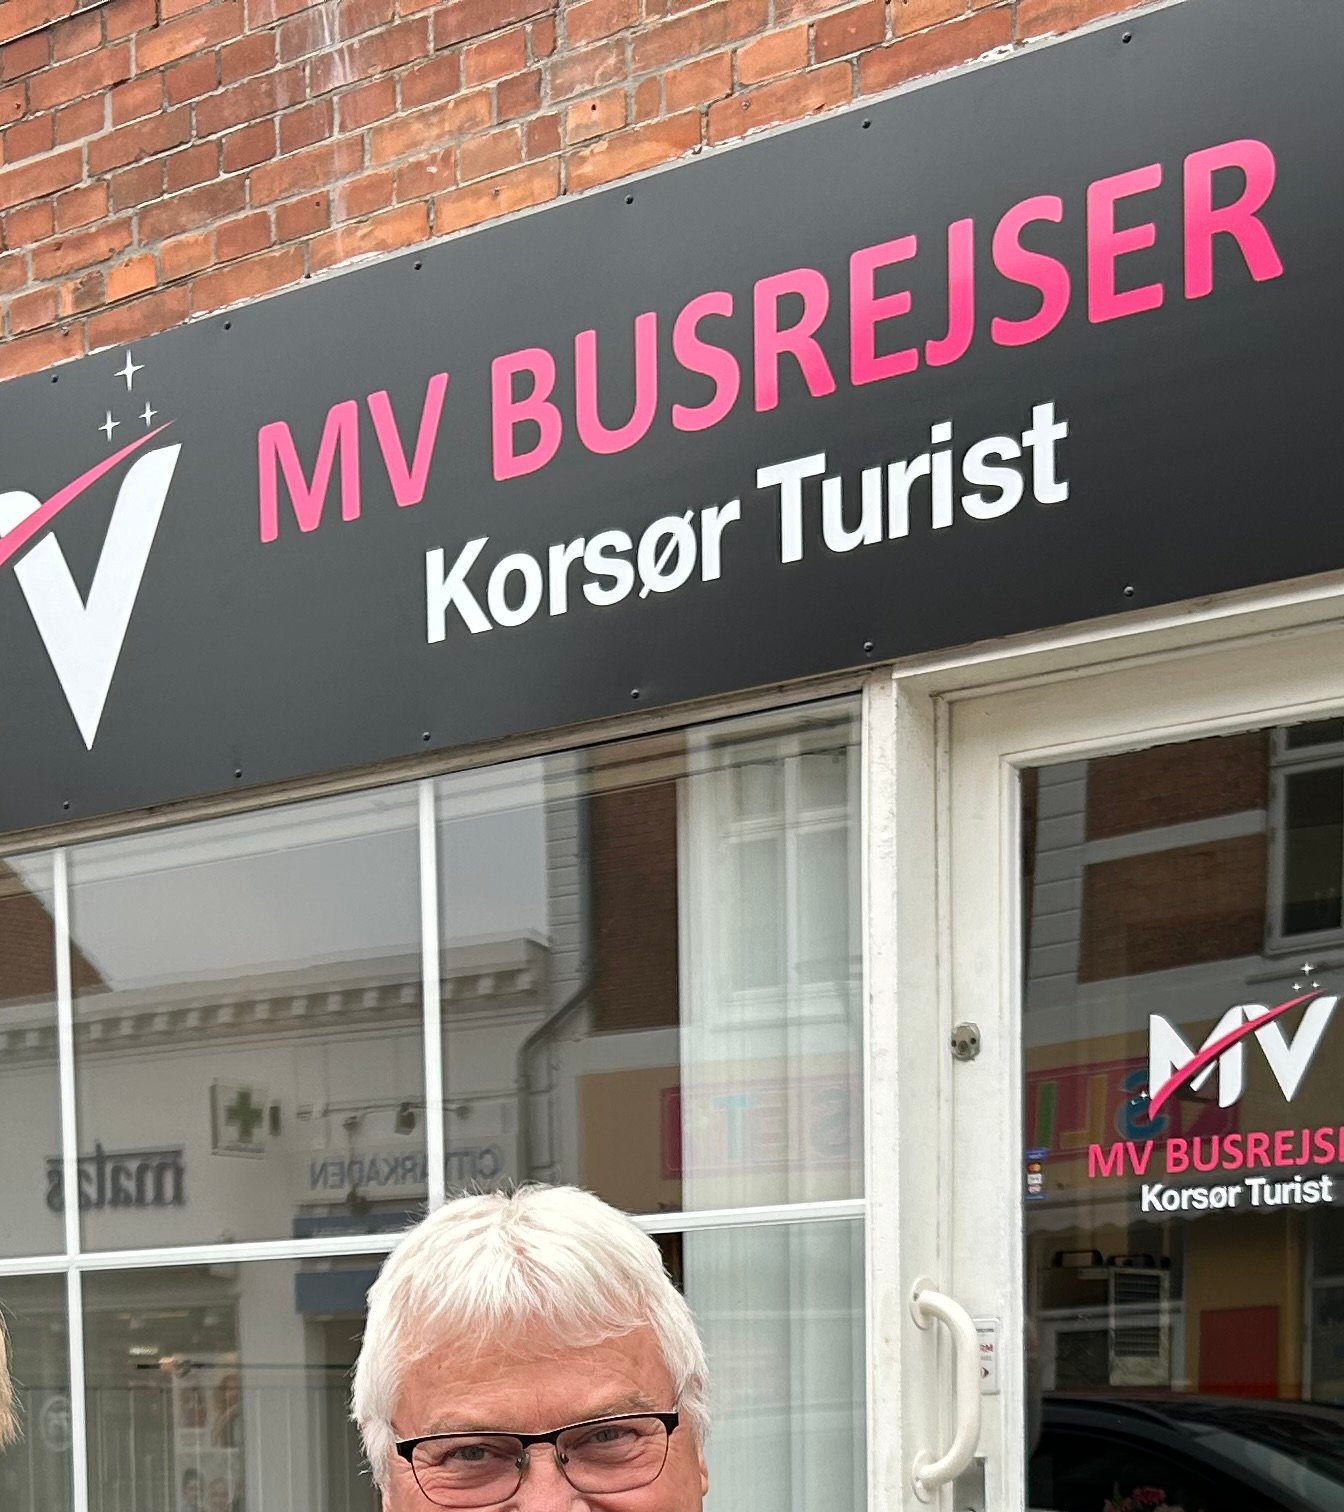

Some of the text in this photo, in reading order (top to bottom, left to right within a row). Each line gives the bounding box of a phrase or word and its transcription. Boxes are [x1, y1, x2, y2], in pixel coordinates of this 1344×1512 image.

[257, 137, 1284, 543] MV BUSREJSER
[424, 402, 1070, 645] Korsør Turist
[1087, 1139, 1154, 1179] MV
[1140, 1174, 1335, 1213] Korsør Turist
